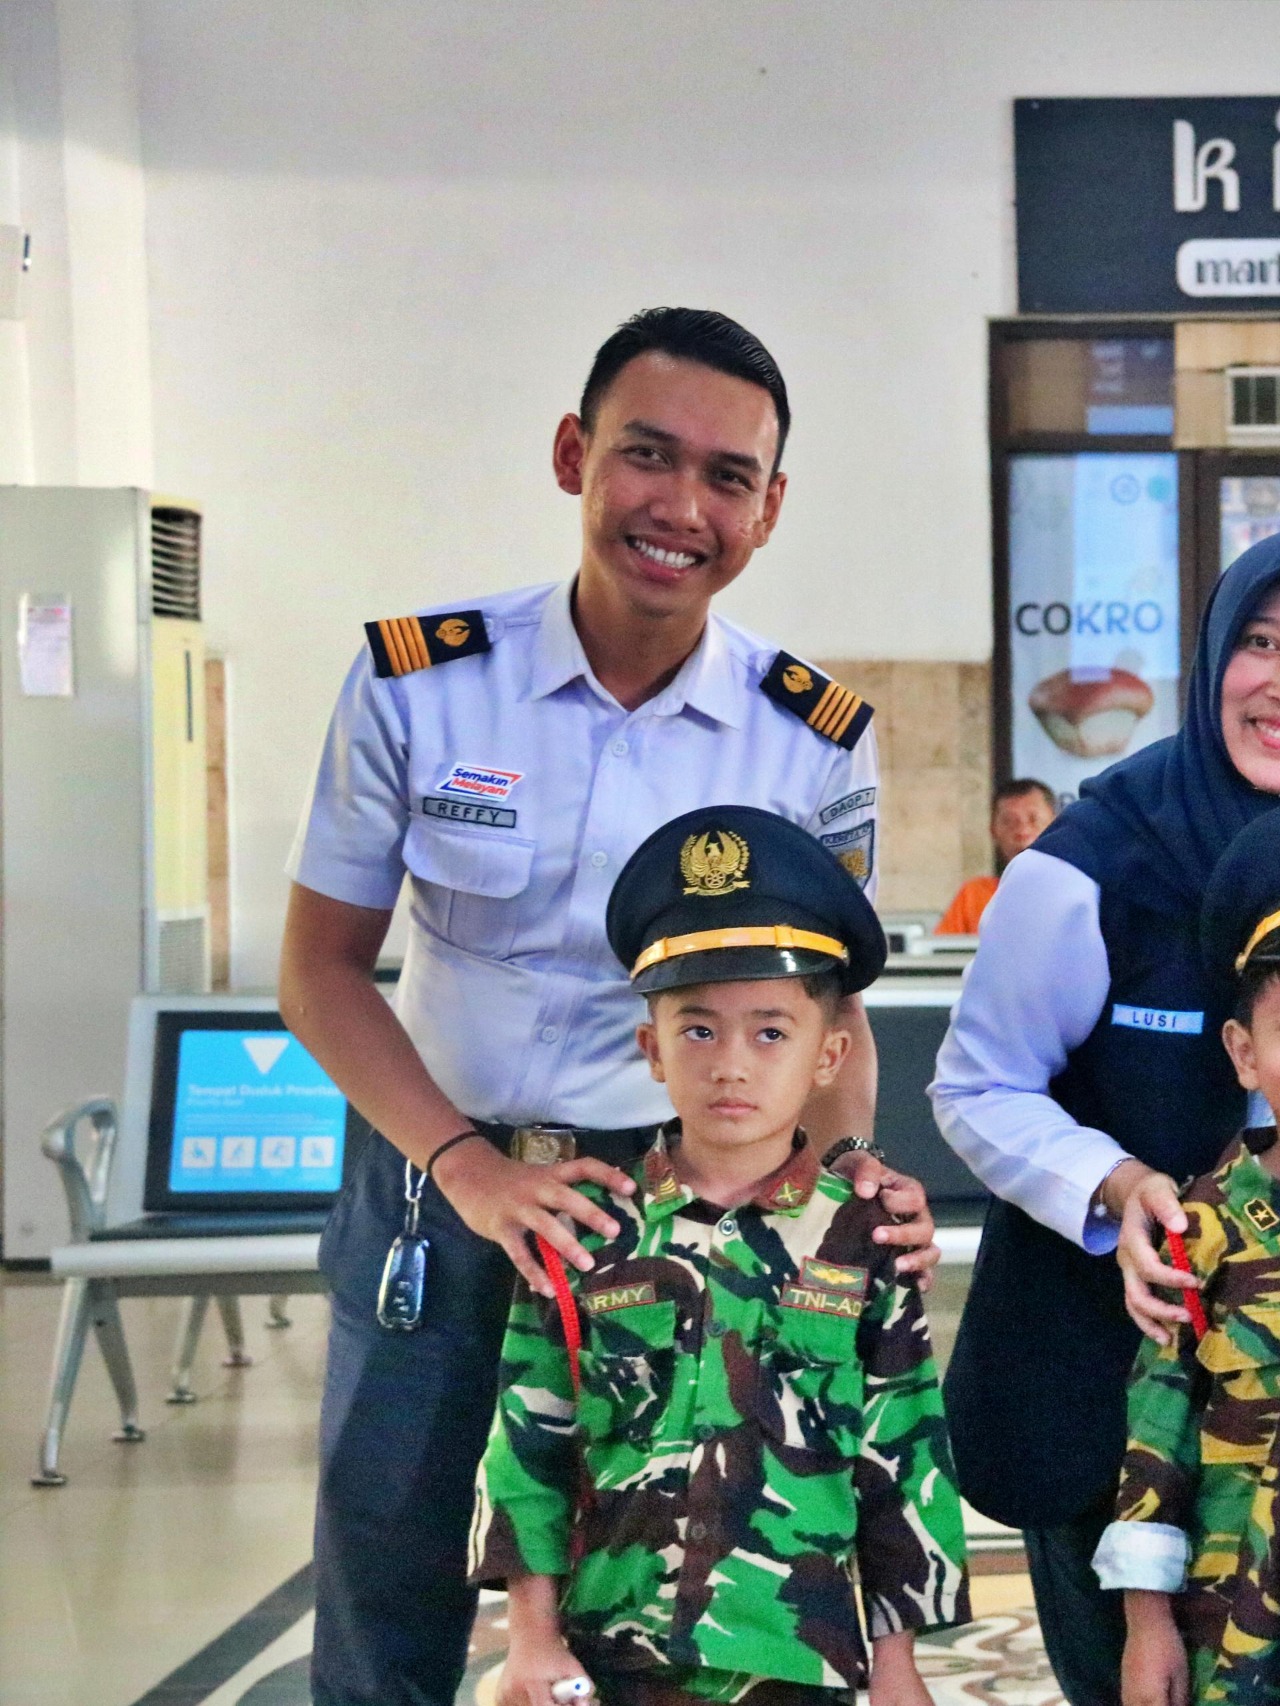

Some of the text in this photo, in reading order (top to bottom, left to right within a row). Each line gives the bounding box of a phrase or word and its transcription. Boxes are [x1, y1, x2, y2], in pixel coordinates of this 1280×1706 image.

[1015, 601, 1164, 636] COKRO
[453, 768, 508, 786] Semakin
[453, 778, 508, 796] Melayani
[438, 803, 500, 823] REFFY
[830, 794, 862, 817] DAOP
[1132, 1010, 1178, 1029] LUSI
[790, 1287, 863, 1317] TNI-AD
